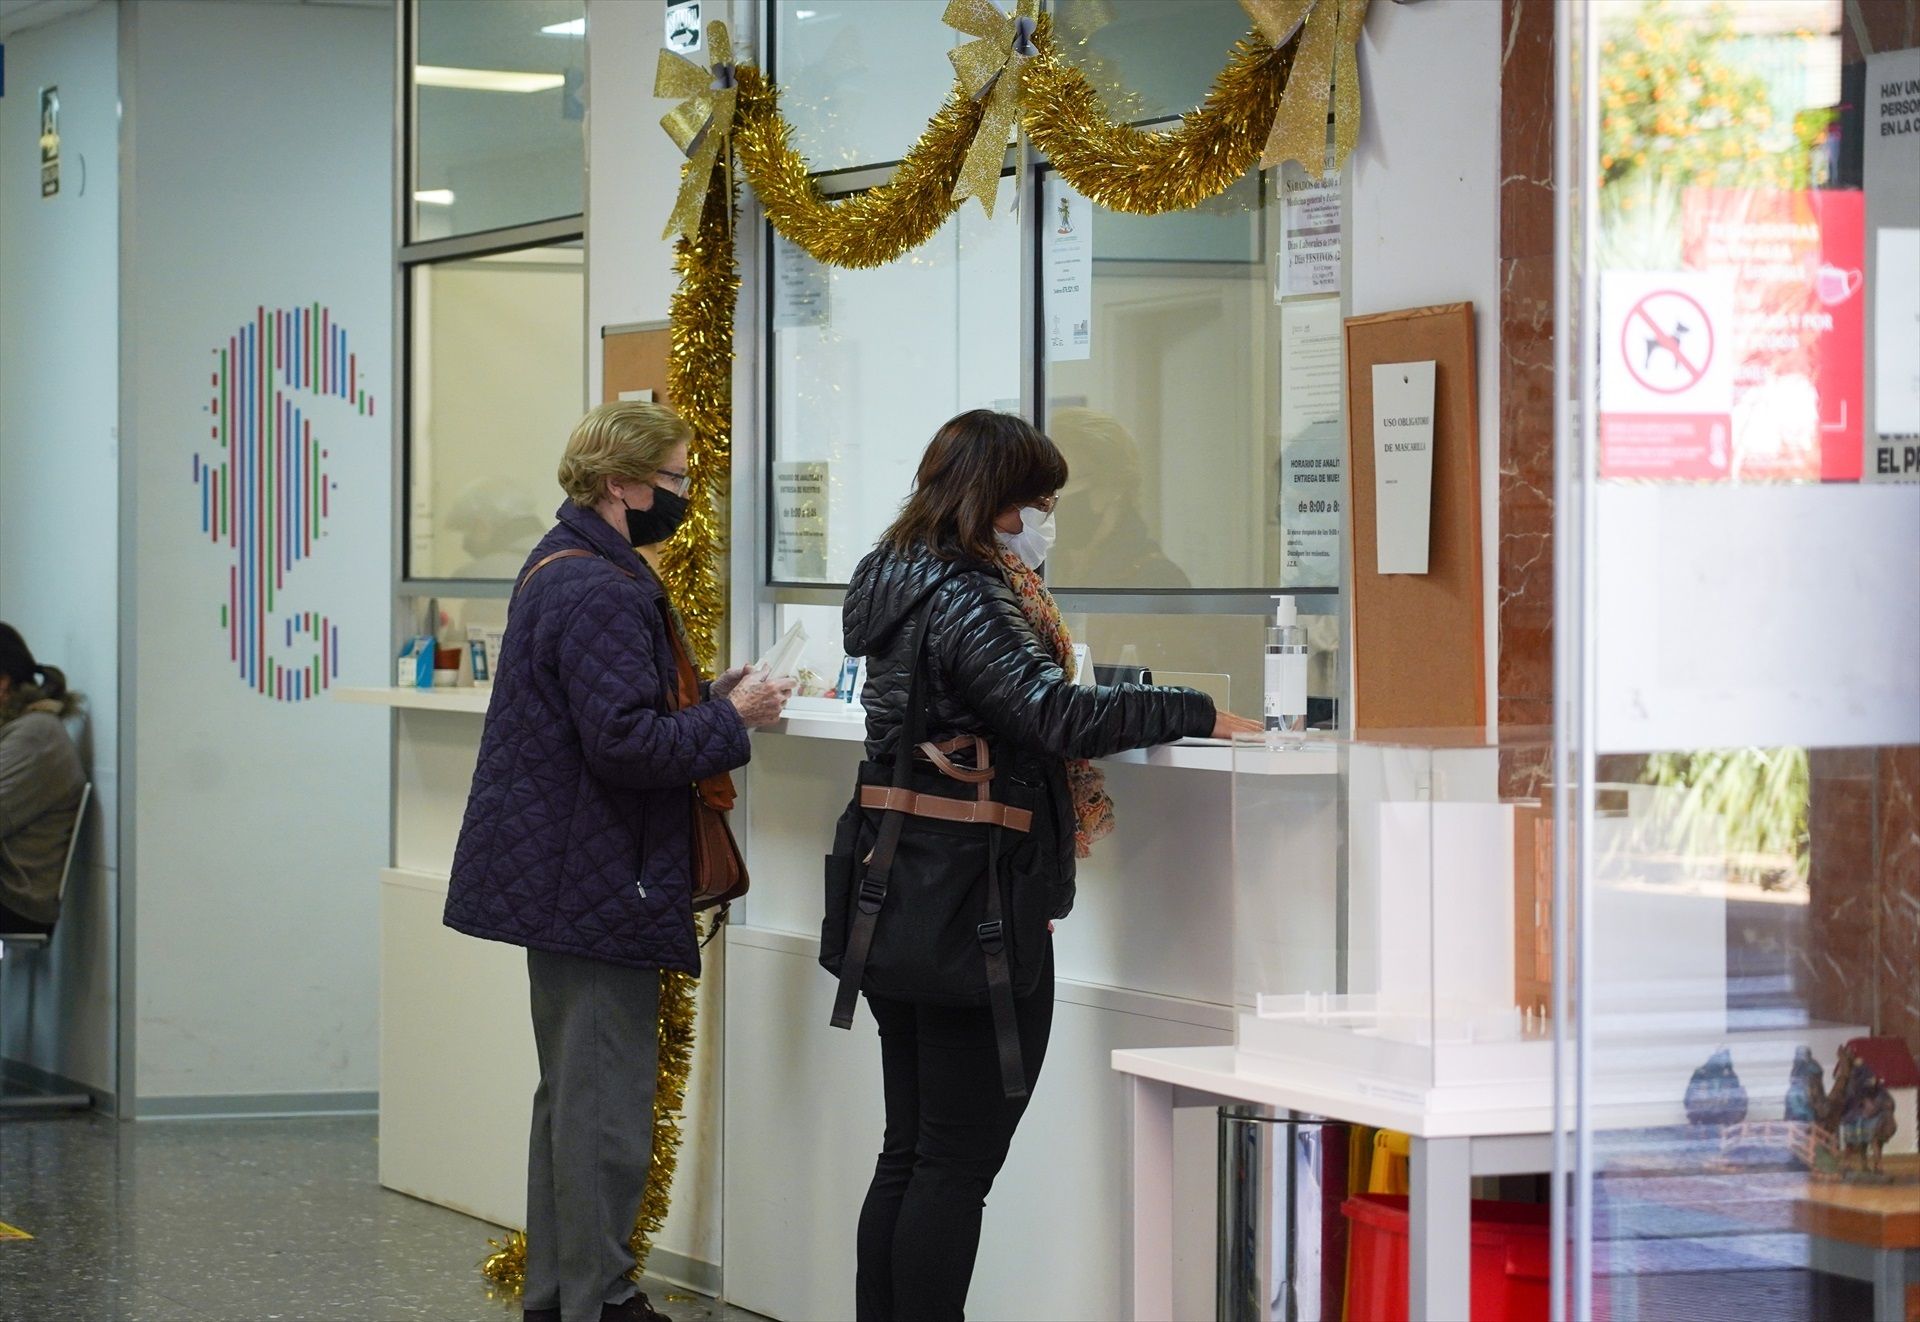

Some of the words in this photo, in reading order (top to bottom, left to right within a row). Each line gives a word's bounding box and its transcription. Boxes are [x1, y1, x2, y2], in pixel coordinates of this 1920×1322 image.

[1881, 81, 1903, 98] HAY
[1881, 120, 1895, 136] EN
[1897, 118, 1911, 134] LA
[1383, 418, 1396, 427] USO
[1384, 444, 1393, 453] DE
[1395, 442, 1426, 452] MASCARILLA
[1290, 459, 1314, 468] HORARIO
[1315, 459, 1321, 468] DE
[1877, 446, 1901, 474] EL
[1294, 474, 1318, 483] ENTREGA
[1318, 474, 1326, 482] DE
[1298, 500, 1308, 513] de
[1309, 500, 1326, 513] 8:00
[1326, 503, 1332, 513] a
